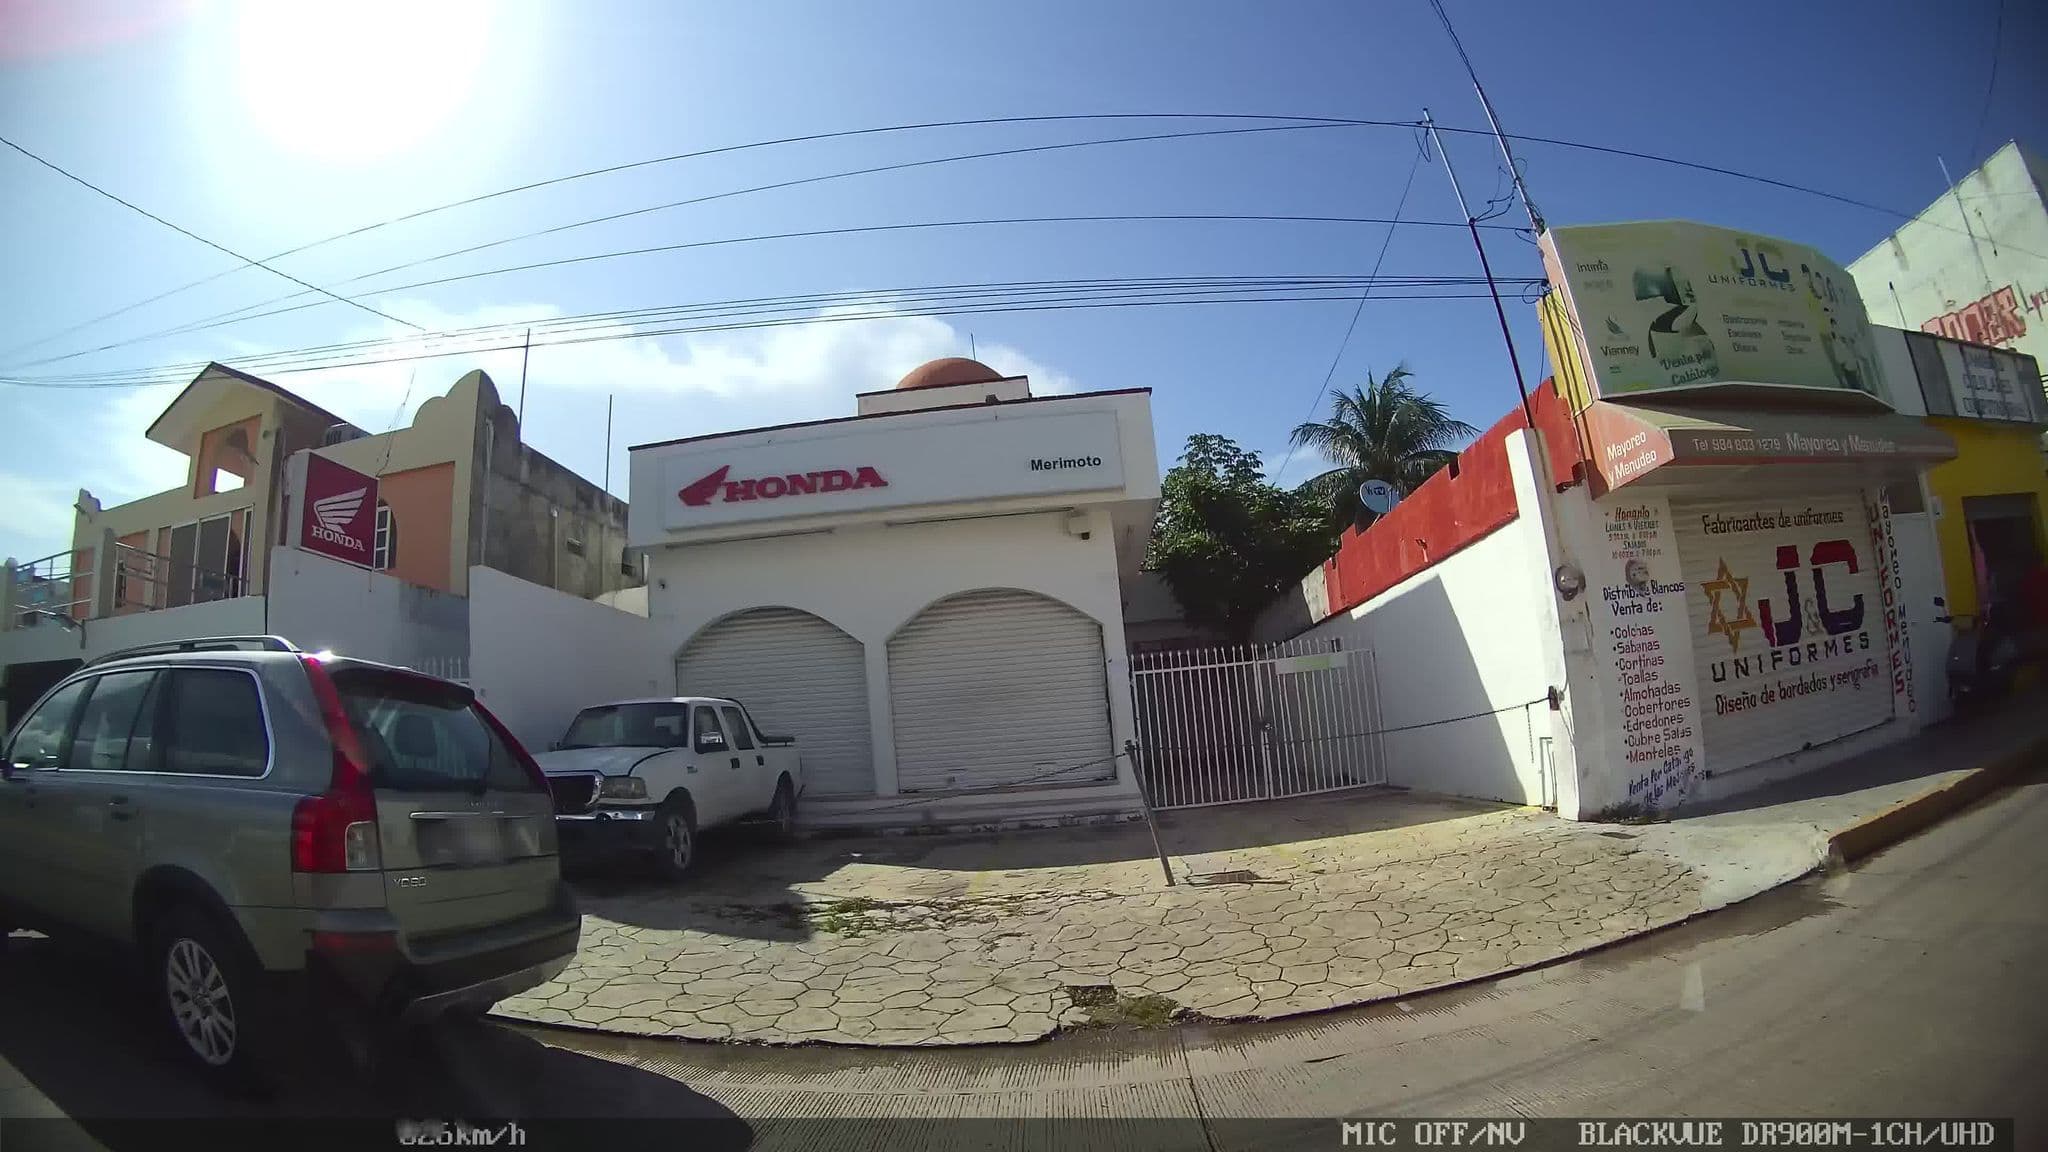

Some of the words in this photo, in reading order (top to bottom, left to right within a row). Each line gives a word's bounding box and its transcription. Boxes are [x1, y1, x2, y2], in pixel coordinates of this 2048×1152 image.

[1707, 274, 1796, 293] UNIFORMES
[1600, 345, 1640, 357] Vianney
[1659, 353, 1694, 370] Venta
[1607, 431, 1647, 461] Mayoreo
[1693, 438, 1709, 451] Tel
[1712, 438, 1733, 451] 984
[1785, 431, 1840, 456] Mayoreo
[1841, 440, 1849, 457] y
[1848, 434, 1896, 453] Menudeo
[1030, 455, 1101, 472] Merimoto
[1608, 468, 1616, 484] y
[1615, 448, 1658, 478] Menudeo
[723, 466, 889, 503] HONDA
[1702, 511, 1775, 535] Fabricantes
[1778, 511, 1791, 528] de
[1794, 507, 1844, 526] uniformes
[312, 525, 366, 552] HONDA
[1650, 579, 1685, 596] Blancos
[1612, 600, 1643, 617] Venta
[1646, 597, 1663, 613] de:
[1619, 654, 1665, 671] Cortinas
[1711, 631, 1870, 683] UNIFORMES
[1621, 669, 1659, 685] Toallas
[1624, 680, 1681, 703] Almohadas
[1715, 691, 1757, 716] Diseño
[1760, 683, 1776, 705] de
[1778, 672, 1828, 700] bordados
[1624, 696, 1691, 718] Cobertores
[1626, 713, 1684, 732] Edredones
[1628, 731, 1661, 748] Cubre
[1662, 727, 1692, 742] Salas
[1629, 742, 1681, 763] Manteles
